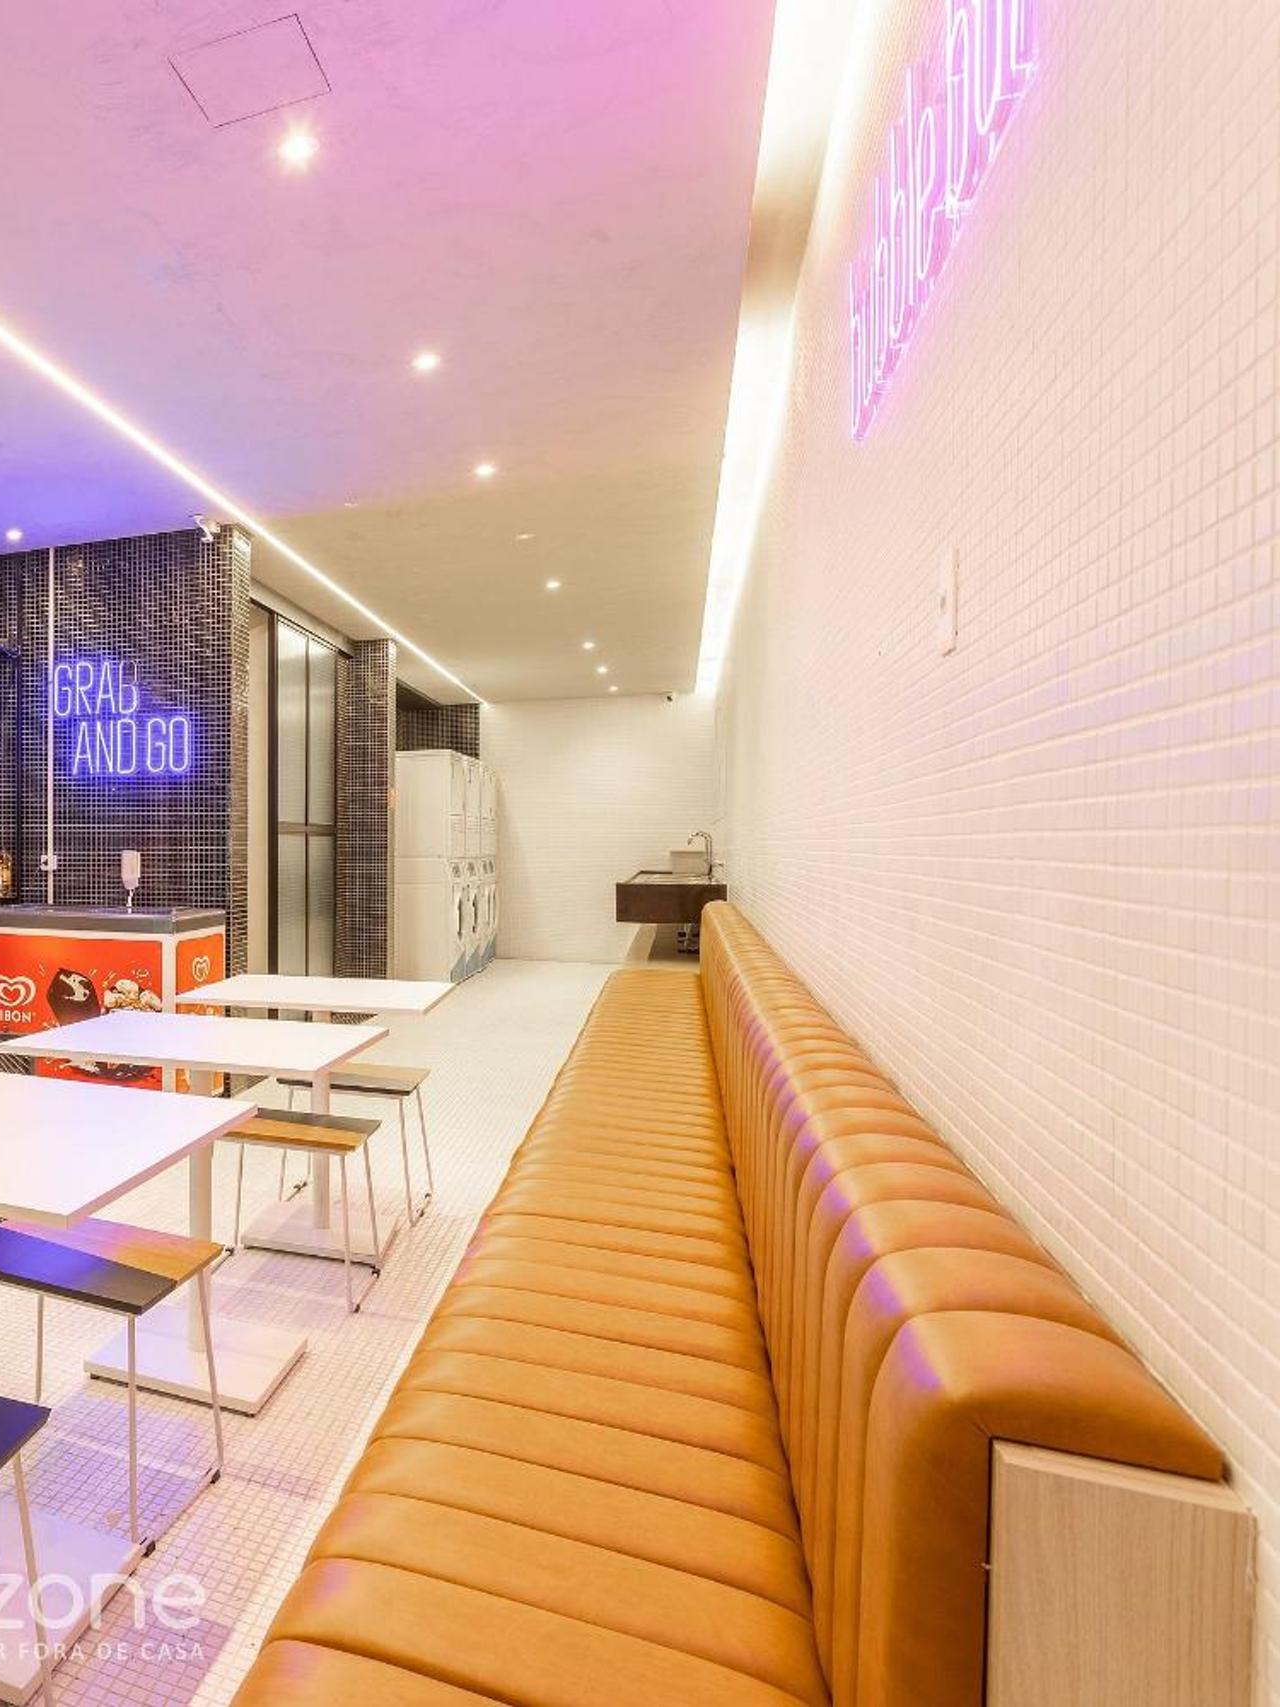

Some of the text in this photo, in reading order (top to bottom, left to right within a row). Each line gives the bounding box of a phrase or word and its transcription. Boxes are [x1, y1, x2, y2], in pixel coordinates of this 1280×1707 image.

[53, 660, 139, 716] GRAB
[72, 716, 189, 775] AND GO
